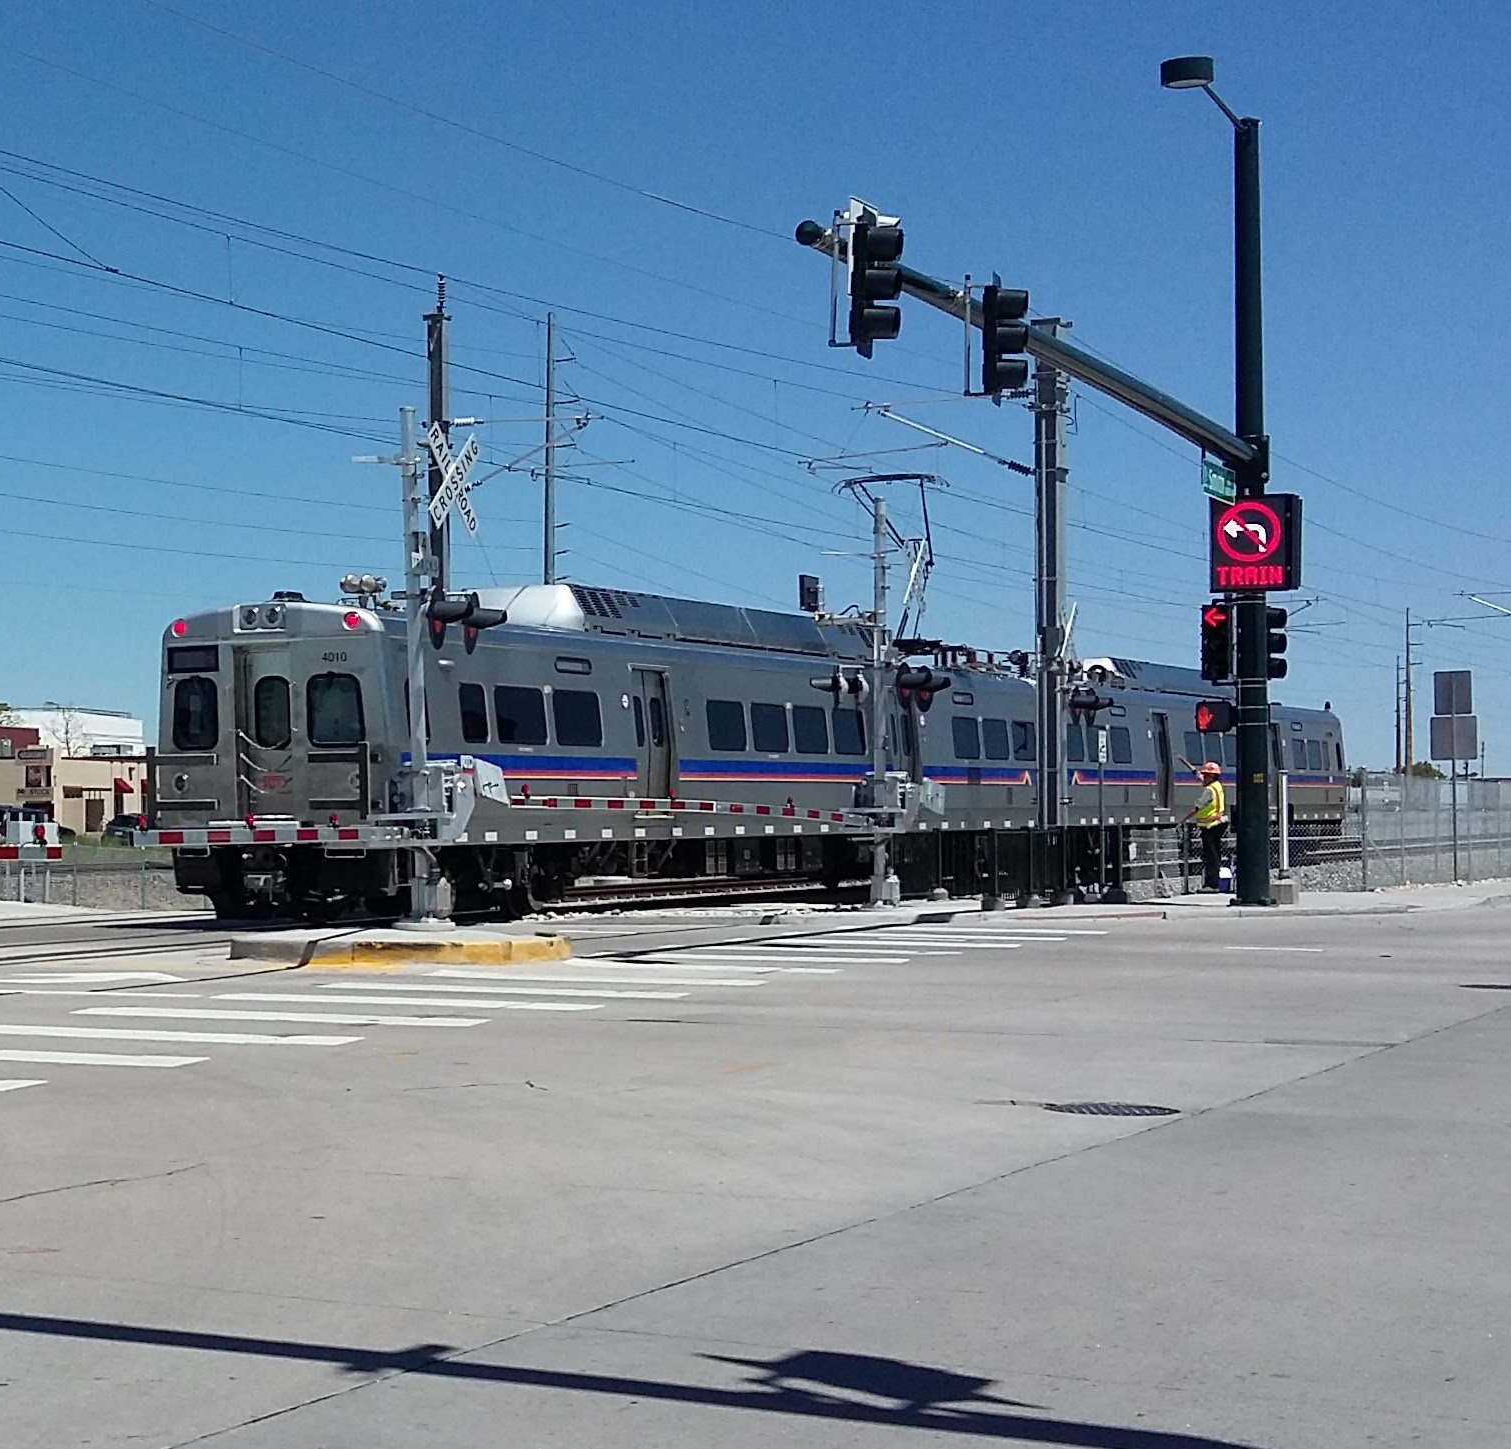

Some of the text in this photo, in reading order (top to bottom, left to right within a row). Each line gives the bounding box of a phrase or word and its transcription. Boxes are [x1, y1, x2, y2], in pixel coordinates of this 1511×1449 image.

[430, 427, 476, 532] RAIL ROAD
[433, 440, 478, 521] CROSSING
[1216, 565, 1284, 586] TRAIN
[321, 651, 347, 662] 4010
